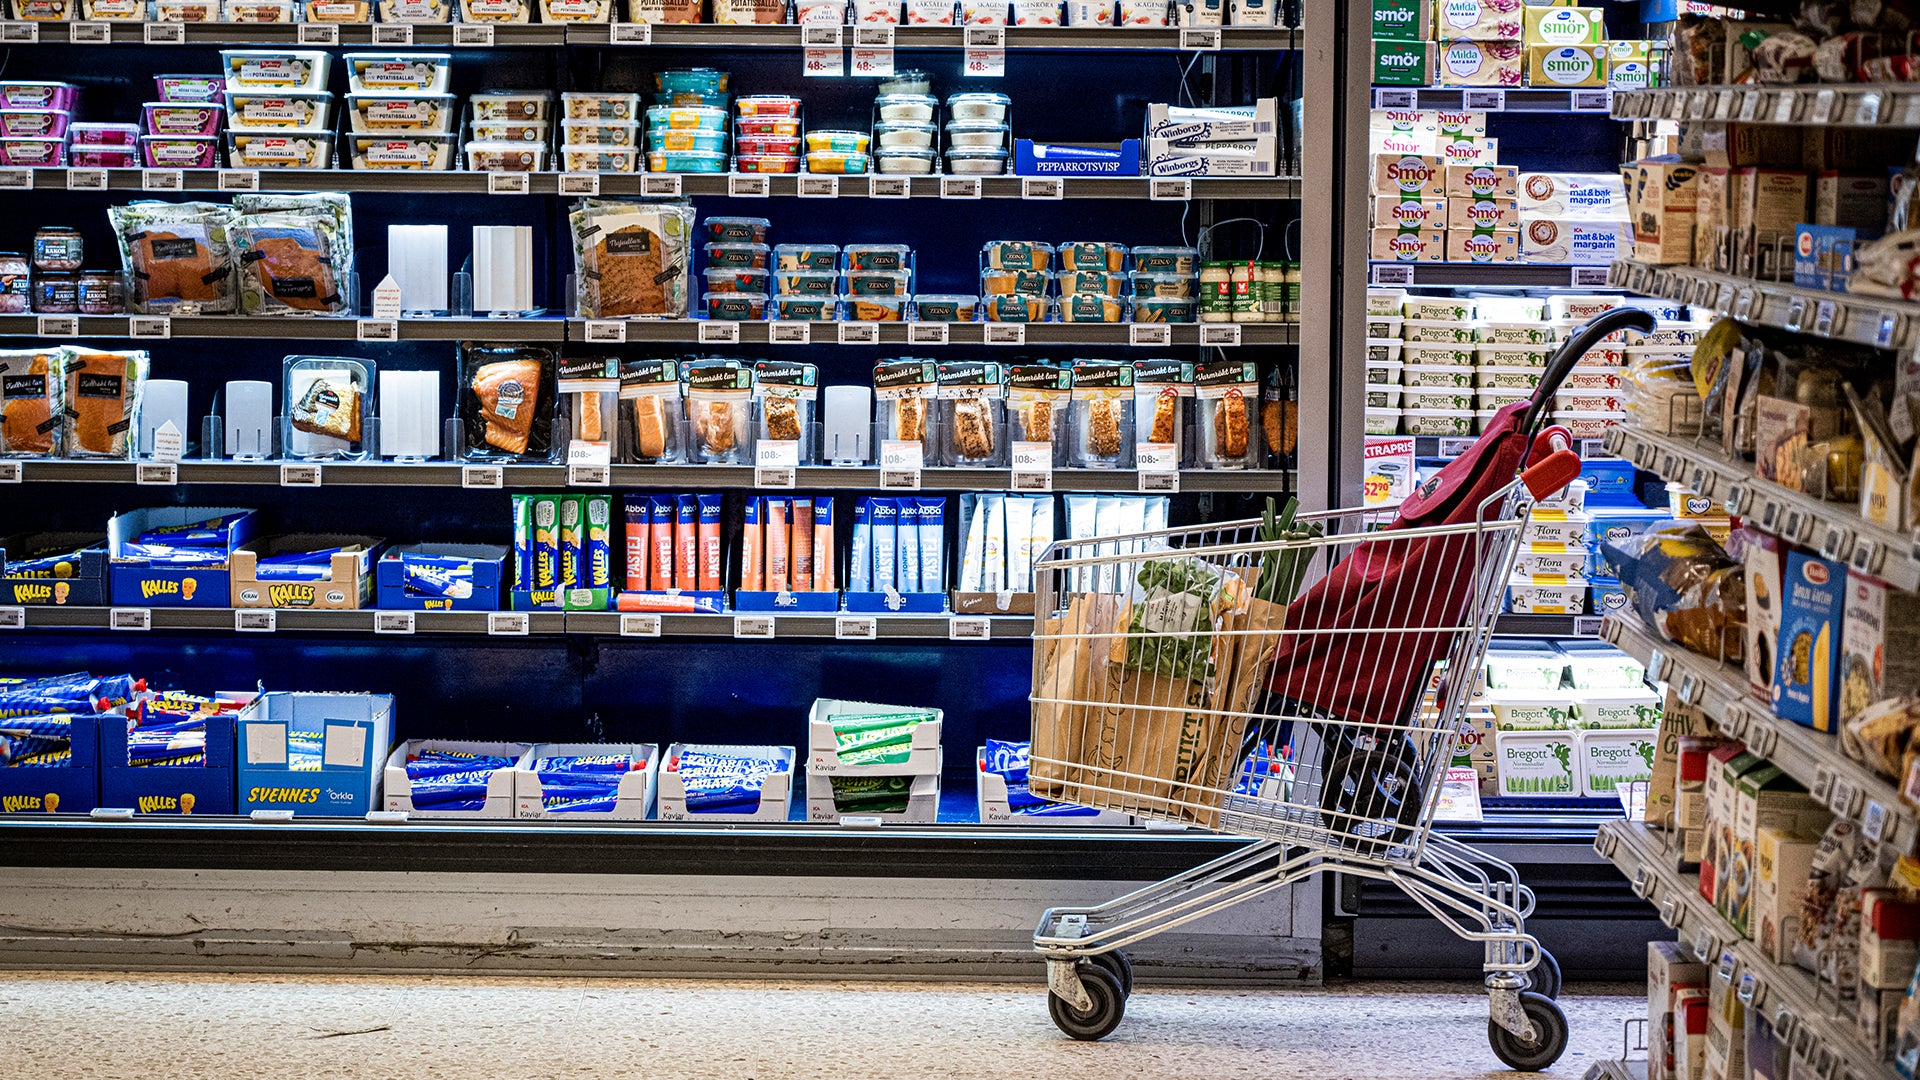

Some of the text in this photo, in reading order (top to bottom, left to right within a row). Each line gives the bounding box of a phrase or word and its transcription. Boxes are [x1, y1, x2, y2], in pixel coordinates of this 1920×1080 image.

[1449, 2, 1476, 11] Milda
[1374, 8, 1414, 21] smör
[1543, 20, 1585, 35] smör
[1613, 44, 1632, 54] smör
[807, 61, 826, 70] 48:-
[856, 61, 875, 70] 48:-
[969, 61, 988, 70] 48:-
[1380, 52, 1420, 66] smör
[1547, 57, 1590, 72] smör
[1386, 111, 1423, 123] Smör
[1438, 111, 1471, 125] Smör
[1161, 124, 1201, 139] Winborgs
[1383, 139, 1420, 152] Smör
[1445, 145, 1481, 158] Smör
[1037, 162, 1120, 172] PEPPARROTSVISP
[1158, 160, 1198, 174] Winborgs
[1387, 163, 1436, 181] Smör
[1465, 173, 1502, 187] Smör
[1570, 196, 1610, 205] margarin
[1392, 206, 1430, 220] Smör
[1467, 206, 1504, 220] Smör
[1389, 239, 1427, 252] Smör
[1464, 240, 1501, 253] Smör
[1574, 241, 1615, 249] margarin
[1420, 305, 1450, 318] Bregott
[1570, 304, 1601, 316] Bregott
[1420, 329, 1450, 341] Bregott
[1495, 329, 1524, 341] Bregott
[1420, 351, 1450, 364] Bregott
[1495, 351, 1524, 364] Bregott
[559, 361, 604, 374] Varmrökt lax
[1135, 369, 1167, 377] Varmrökt
[690, 375, 724, 385] Varmrökt
[756, 370, 786, 379] Varmrökt
[875, 367, 921, 382] Varmrökt lax
[938, 372, 969, 381] Varmrökt
[1011, 375, 1043, 383] Varmrökt
[1074, 374, 1105, 382] Varmrökt
[1196, 370, 1228, 381] Varmrökt
[1420, 373, 1450, 386] Bregott
[1495, 374, 1524, 386] Bregott
[1572, 374, 1603, 386] Bregott
[1420, 395, 1450, 408] Bregott
[1572, 396, 1603, 409] Bregott
[1420, 417, 1450, 430] Bregott
[1572, 419, 1603, 432] Bregott
[760, 451, 781, 459] 108:-
[884, 455, 906, 464] 108:-
[1014, 455, 1036, 464] 108:-
[1138, 455, 1159, 464] 108:-
[625, 505, 646, 513] Abba
[874, 507, 896, 515] Abba
[918, 506, 942, 515] Abba
[1689, 499, 1709, 511] Becel
[1534, 526, 1561, 539] Flora
[1608, 528, 1630, 539] Becel
[627, 536, 640, 578] PASTEJ
[661, 536, 671, 578] PASTEJ
[709, 536, 720, 578] PASTEJ
[880, 539, 893, 580] PASTEJ
[908, 539, 918, 579] PASTEJ
[923, 539, 937, 579] PASTEJ
[1535, 558, 1562, 569] Flora
[539, 551, 554, 586] KALLES
[563, 551, 575, 585] KALLES
[14, 584, 52, 603] KALLES
[141, 580, 179, 598] KALLES
[269, 584, 315, 607] KALLES
[1534, 589, 1562, 602] Flora
[424, 600, 444, 610] KALLES
[531, 592, 554, 605] KALLE
[1606, 595, 1626, 605] Becel
[147, 700, 194, 713] KALLES
[1598, 708, 1630, 718] Bregott
[1511, 709, 1544, 720] Bregott
[1507, 748, 1547, 763] Bregott
[1590, 747, 1632, 762] Bregott
[815, 764, 836, 772] Kaviar
[248, 787, 321, 803] SVENNES
[330, 791, 353, 800] Orkla
[3, 796, 41, 812] KALLES
[138, 796, 177, 813] KALLES
